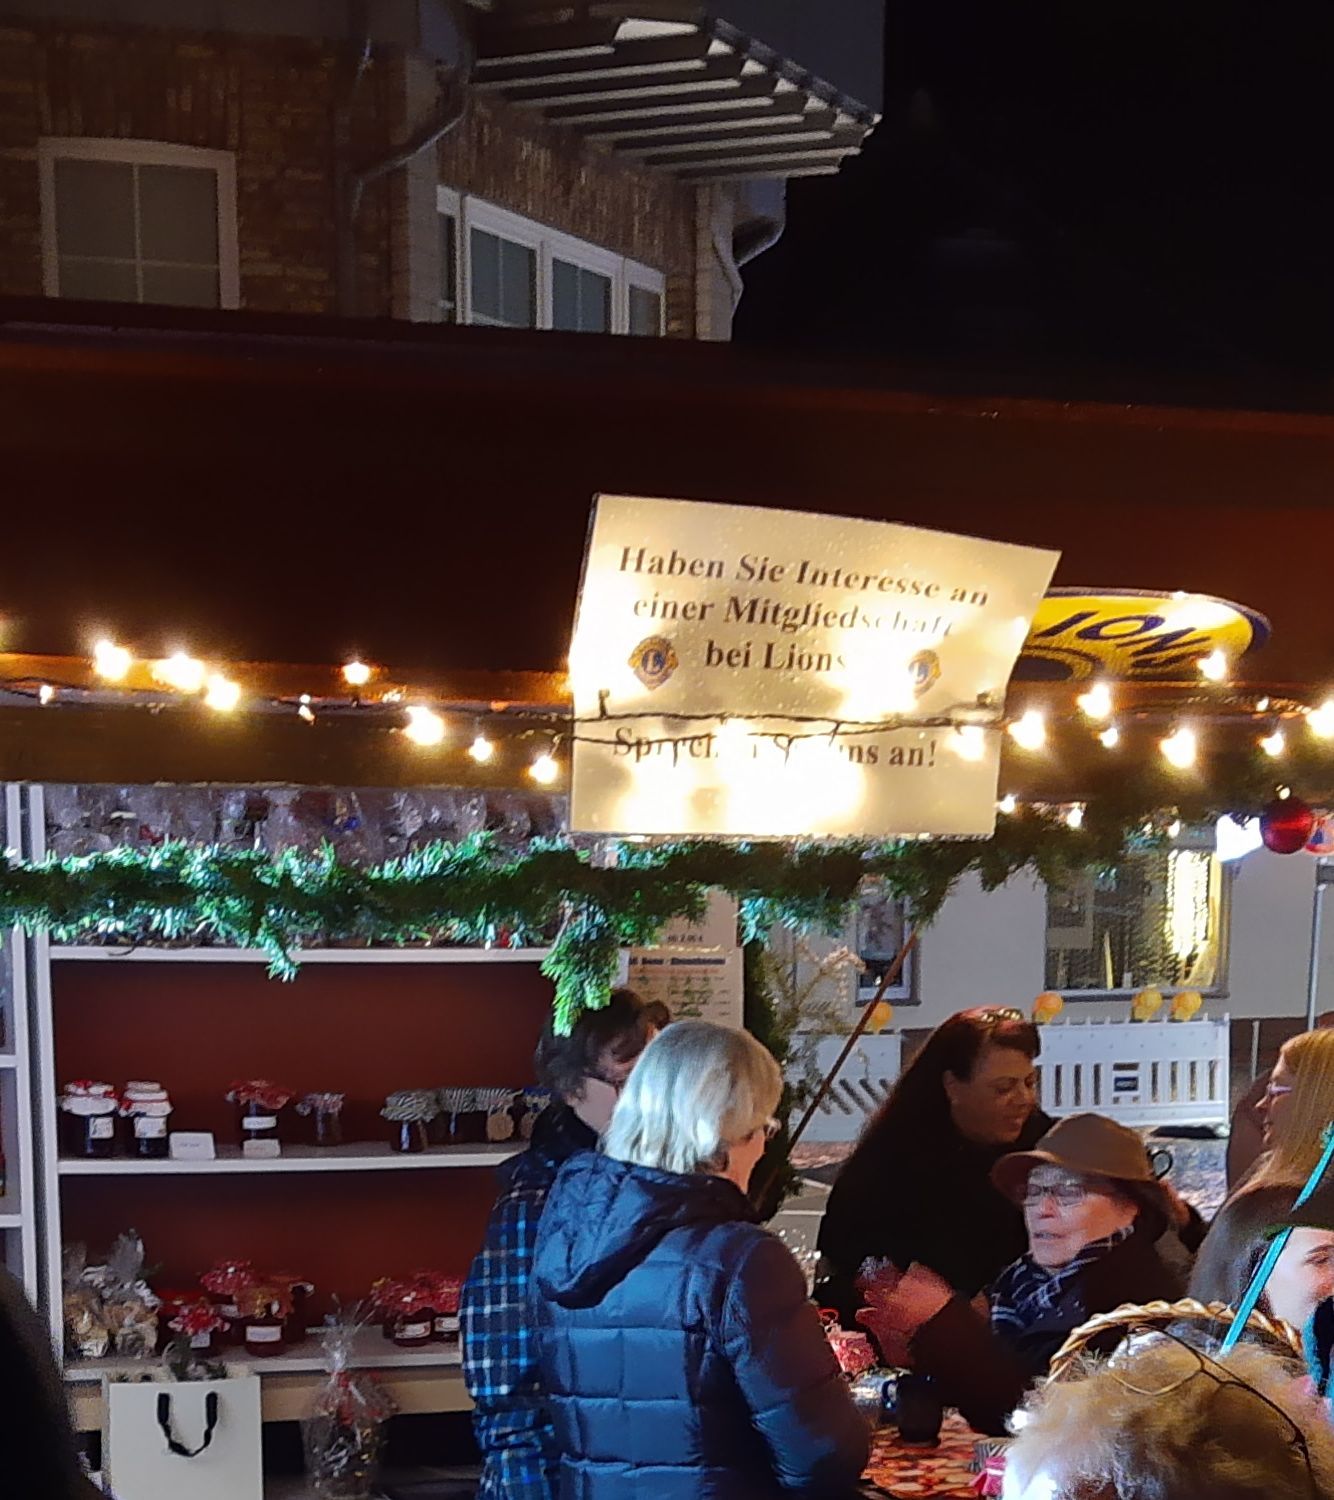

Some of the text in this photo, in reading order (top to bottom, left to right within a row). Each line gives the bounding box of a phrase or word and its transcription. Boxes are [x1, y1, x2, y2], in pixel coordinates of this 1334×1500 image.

[619, 545, 989, 608] Haben Sie Interesse an
[633, 591, 715, 622] einer
[704, 639, 751, 668] bei
[888, 739, 936, 767] an!
